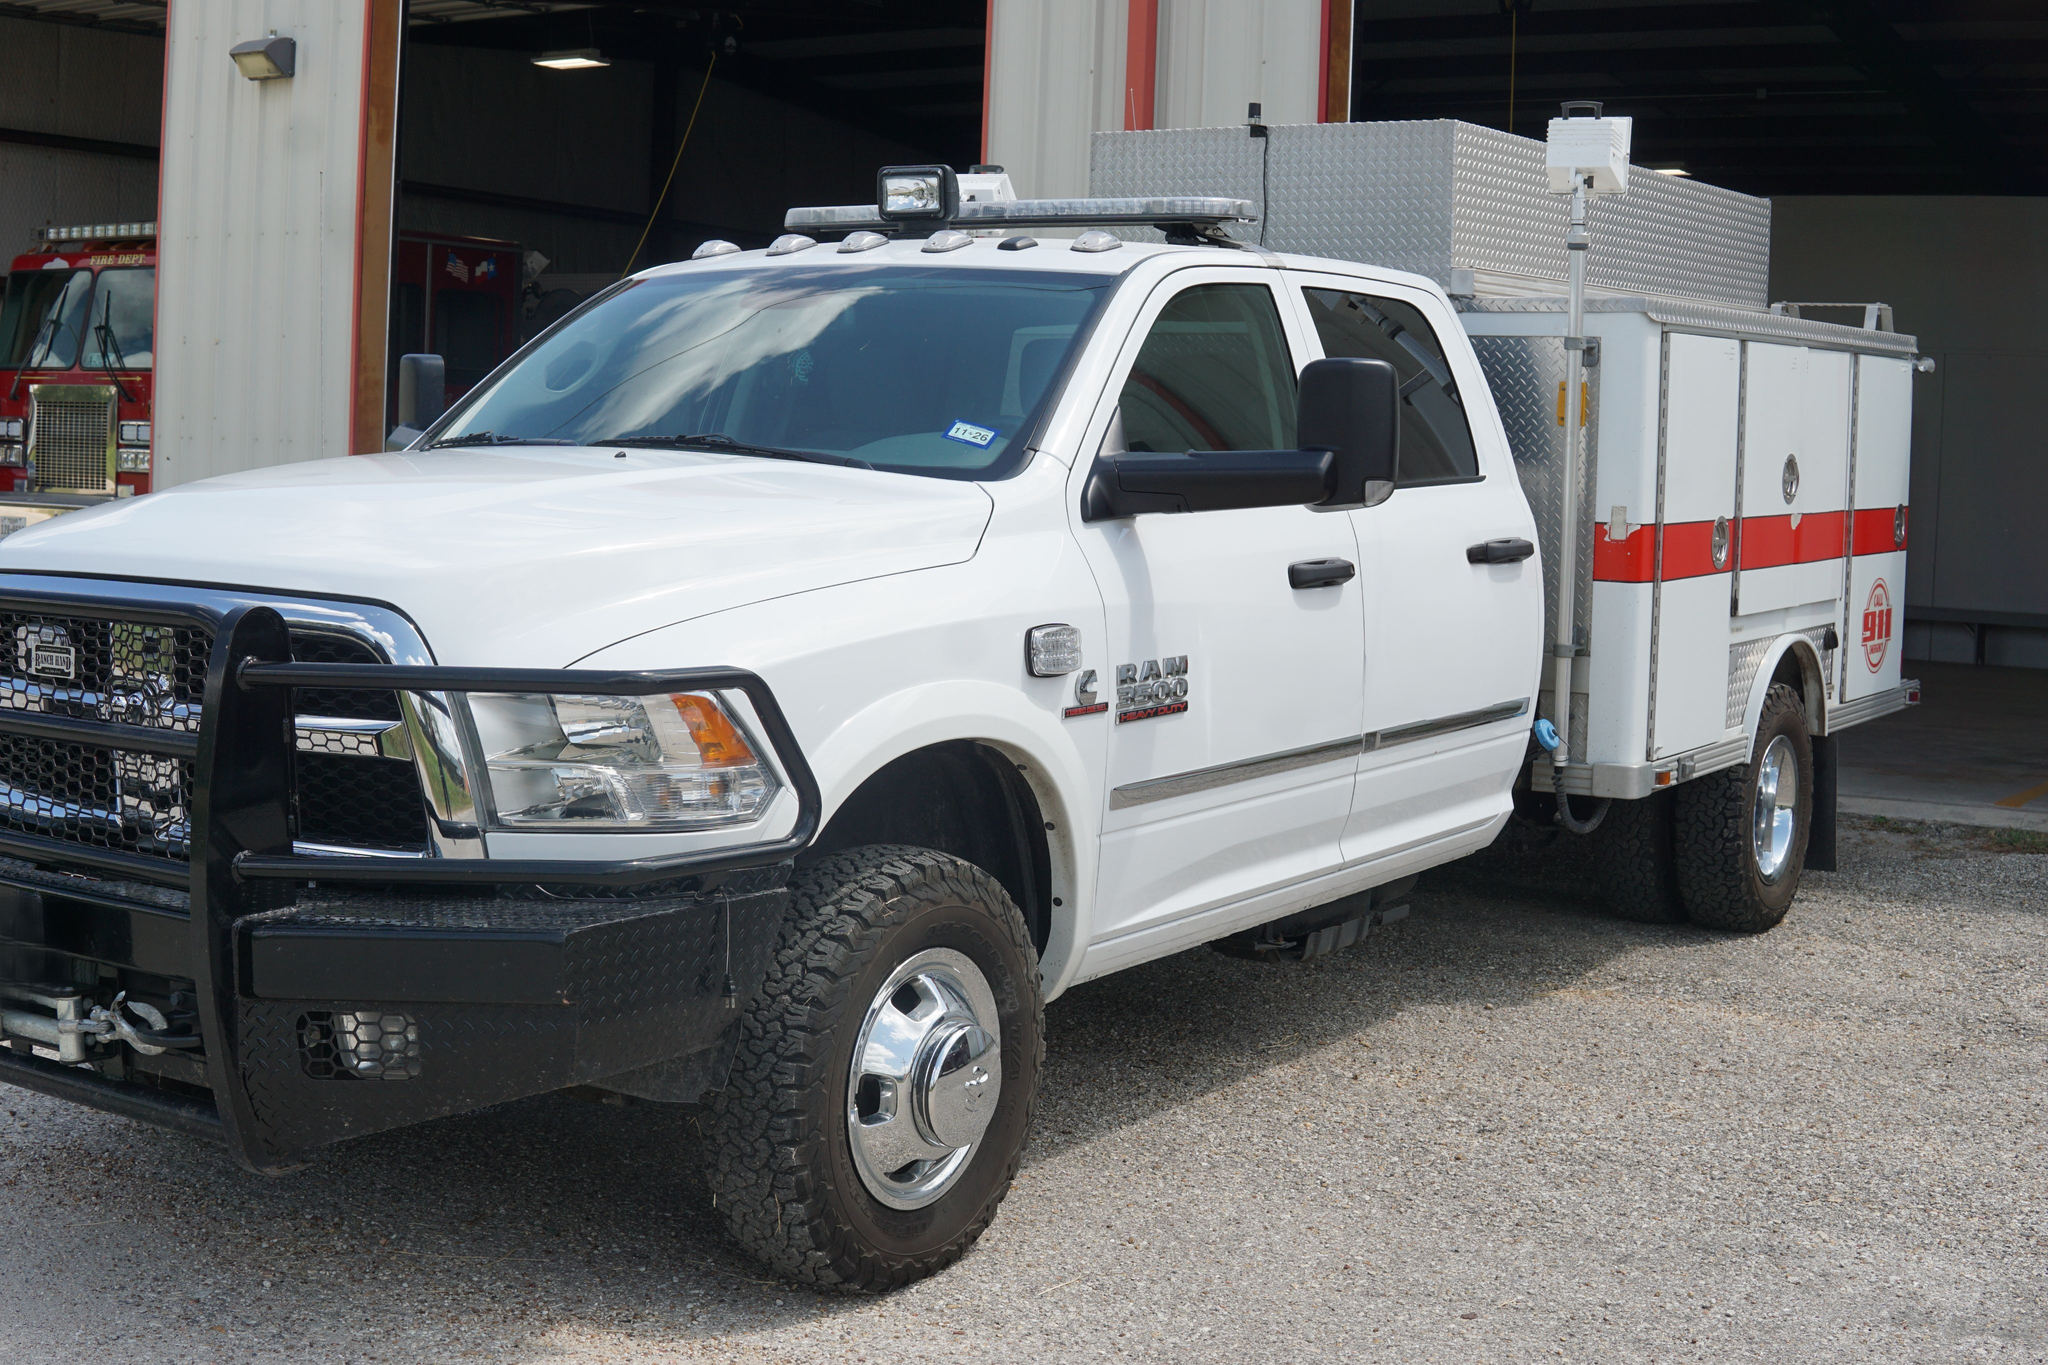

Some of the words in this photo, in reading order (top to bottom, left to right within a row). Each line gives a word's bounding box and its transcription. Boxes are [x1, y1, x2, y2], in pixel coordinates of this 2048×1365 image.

[90, 255, 115, 265] FIRE
[117, 254, 146, 264] DEPT.
[972, 431, 989, 442] 26
[1862, 608, 1892, 643] 911
[35, 653, 54, 667] RANCH
[55, 655, 71, 670] HAND
[1116, 655, 1188, 686] RAM
[1116, 678, 1188, 710] 3500
[1121, 708, 1157, 722] HEAVY
[1157, 703, 1187, 715] DUTY
